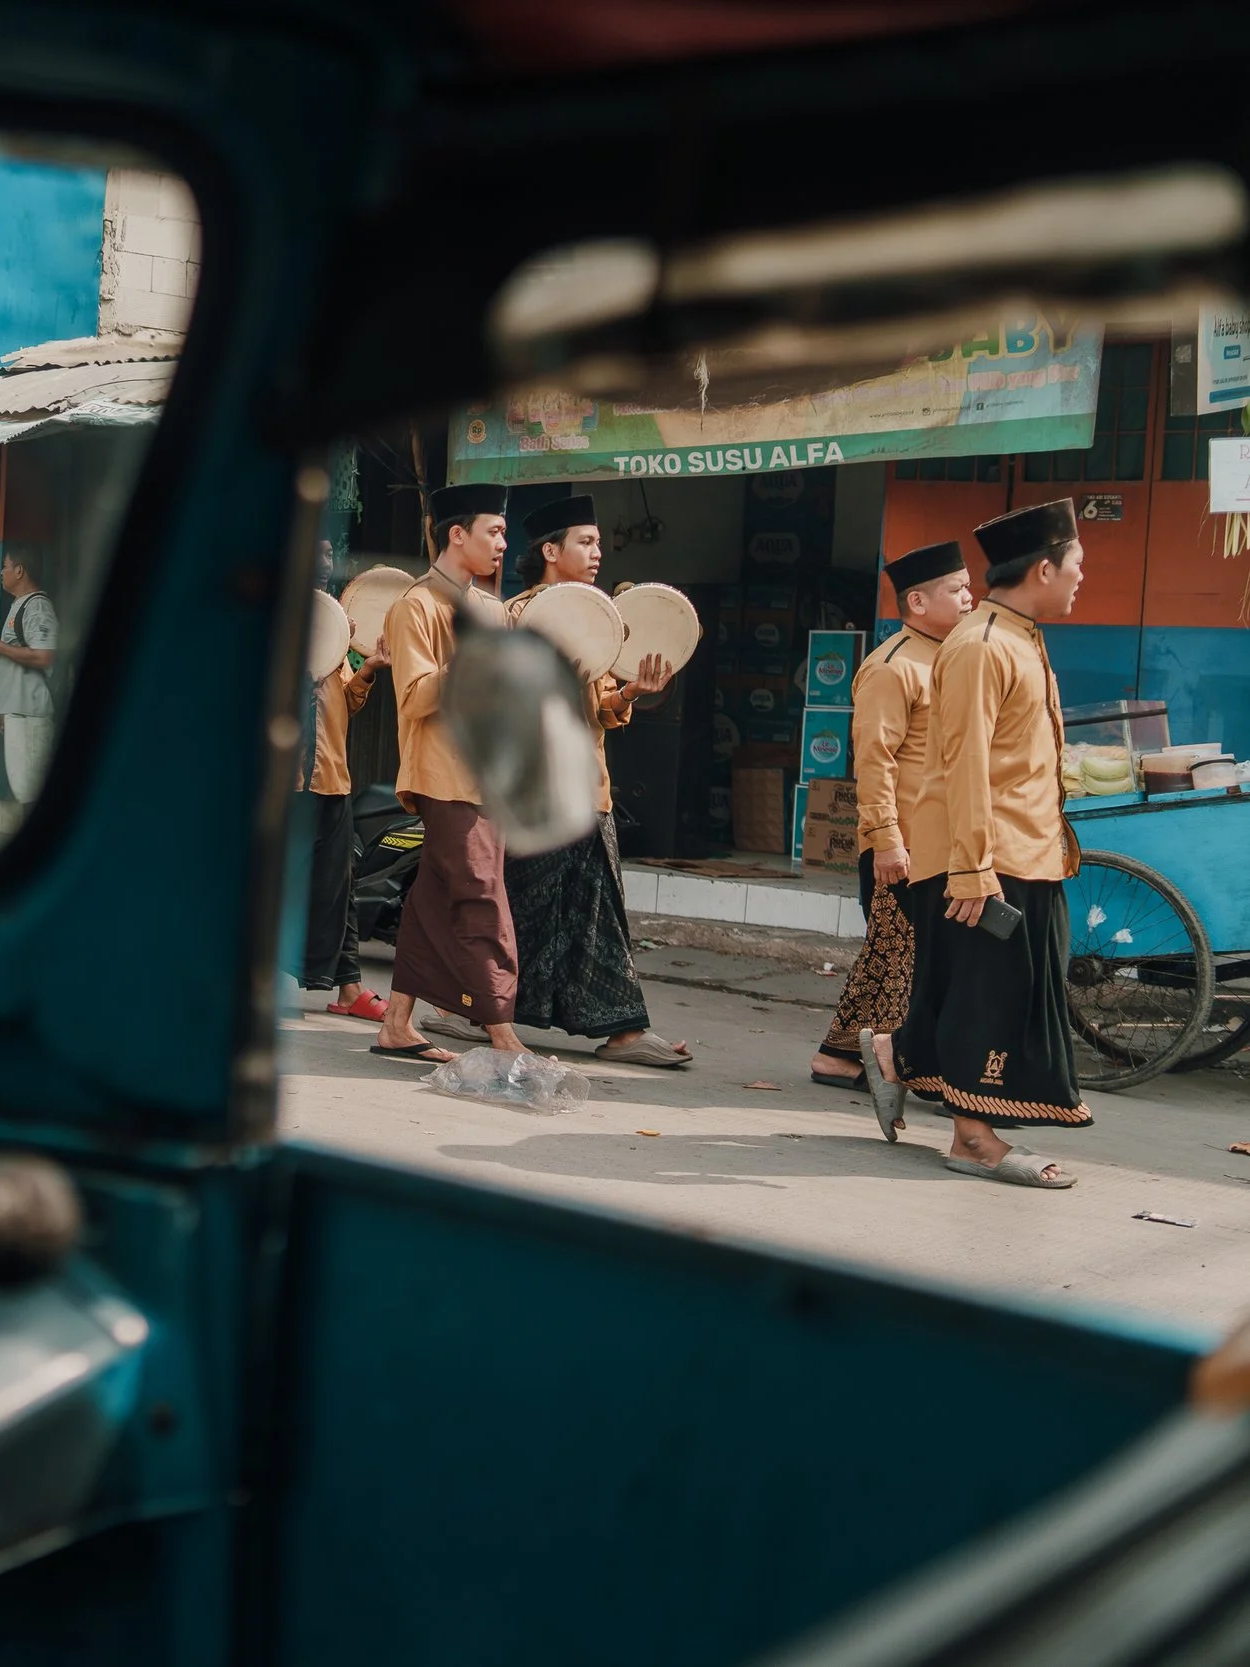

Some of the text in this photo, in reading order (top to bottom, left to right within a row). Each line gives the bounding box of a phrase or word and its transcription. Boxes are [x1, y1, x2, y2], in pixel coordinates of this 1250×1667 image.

[614, 442, 845, 477] TOKO SUSU ALFA
